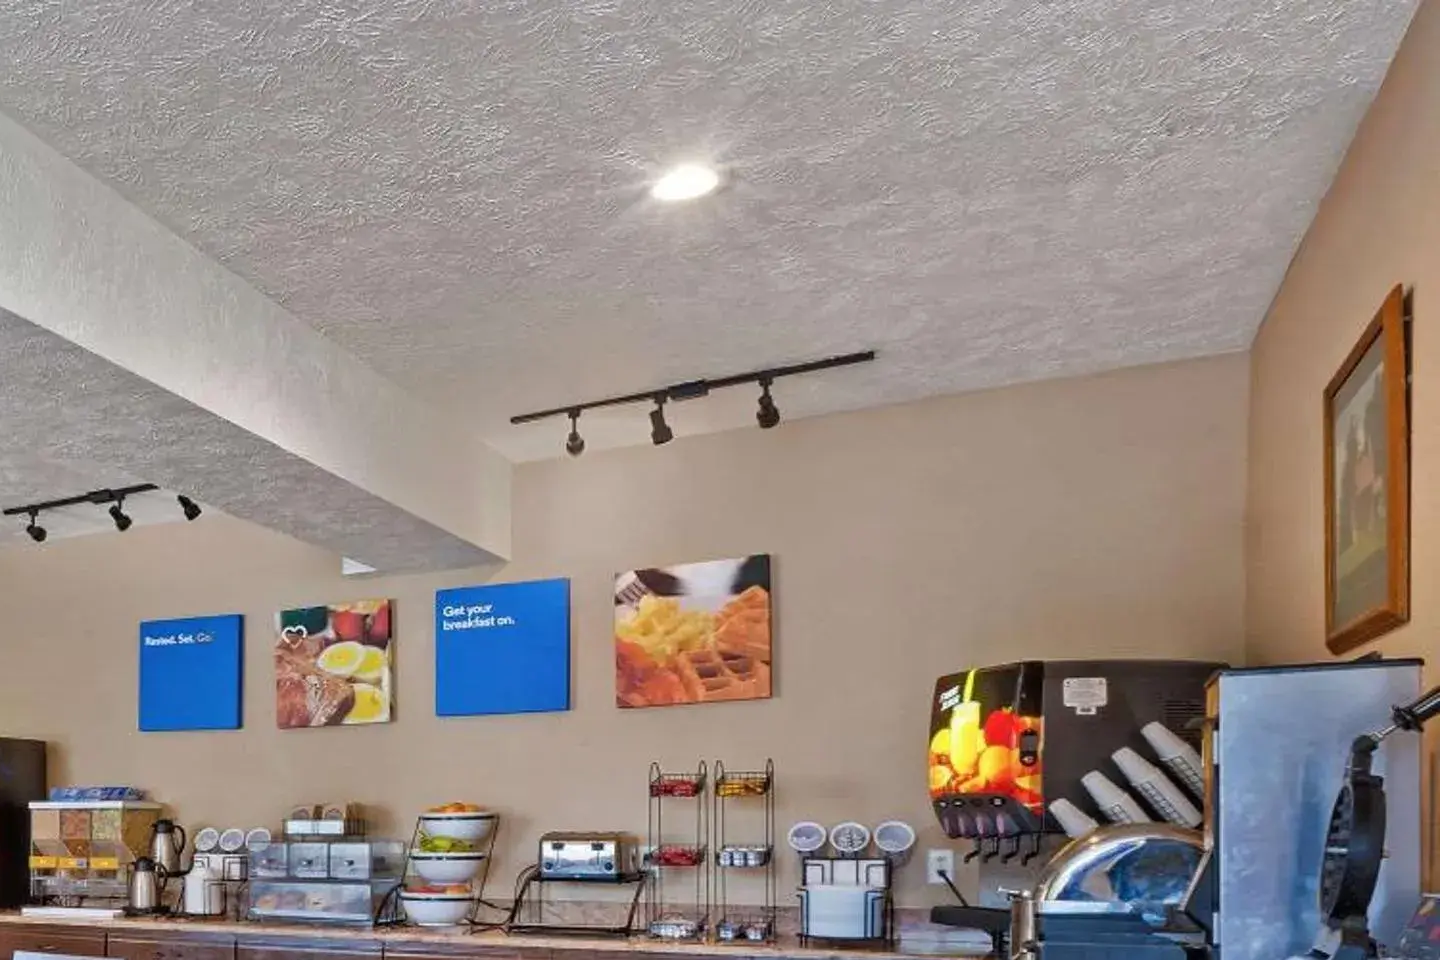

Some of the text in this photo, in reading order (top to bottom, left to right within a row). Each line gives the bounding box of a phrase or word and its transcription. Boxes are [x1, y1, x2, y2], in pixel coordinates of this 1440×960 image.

[443, 604, 493, 617] Get your
[443, 616, 515, 631] breakfast on.
